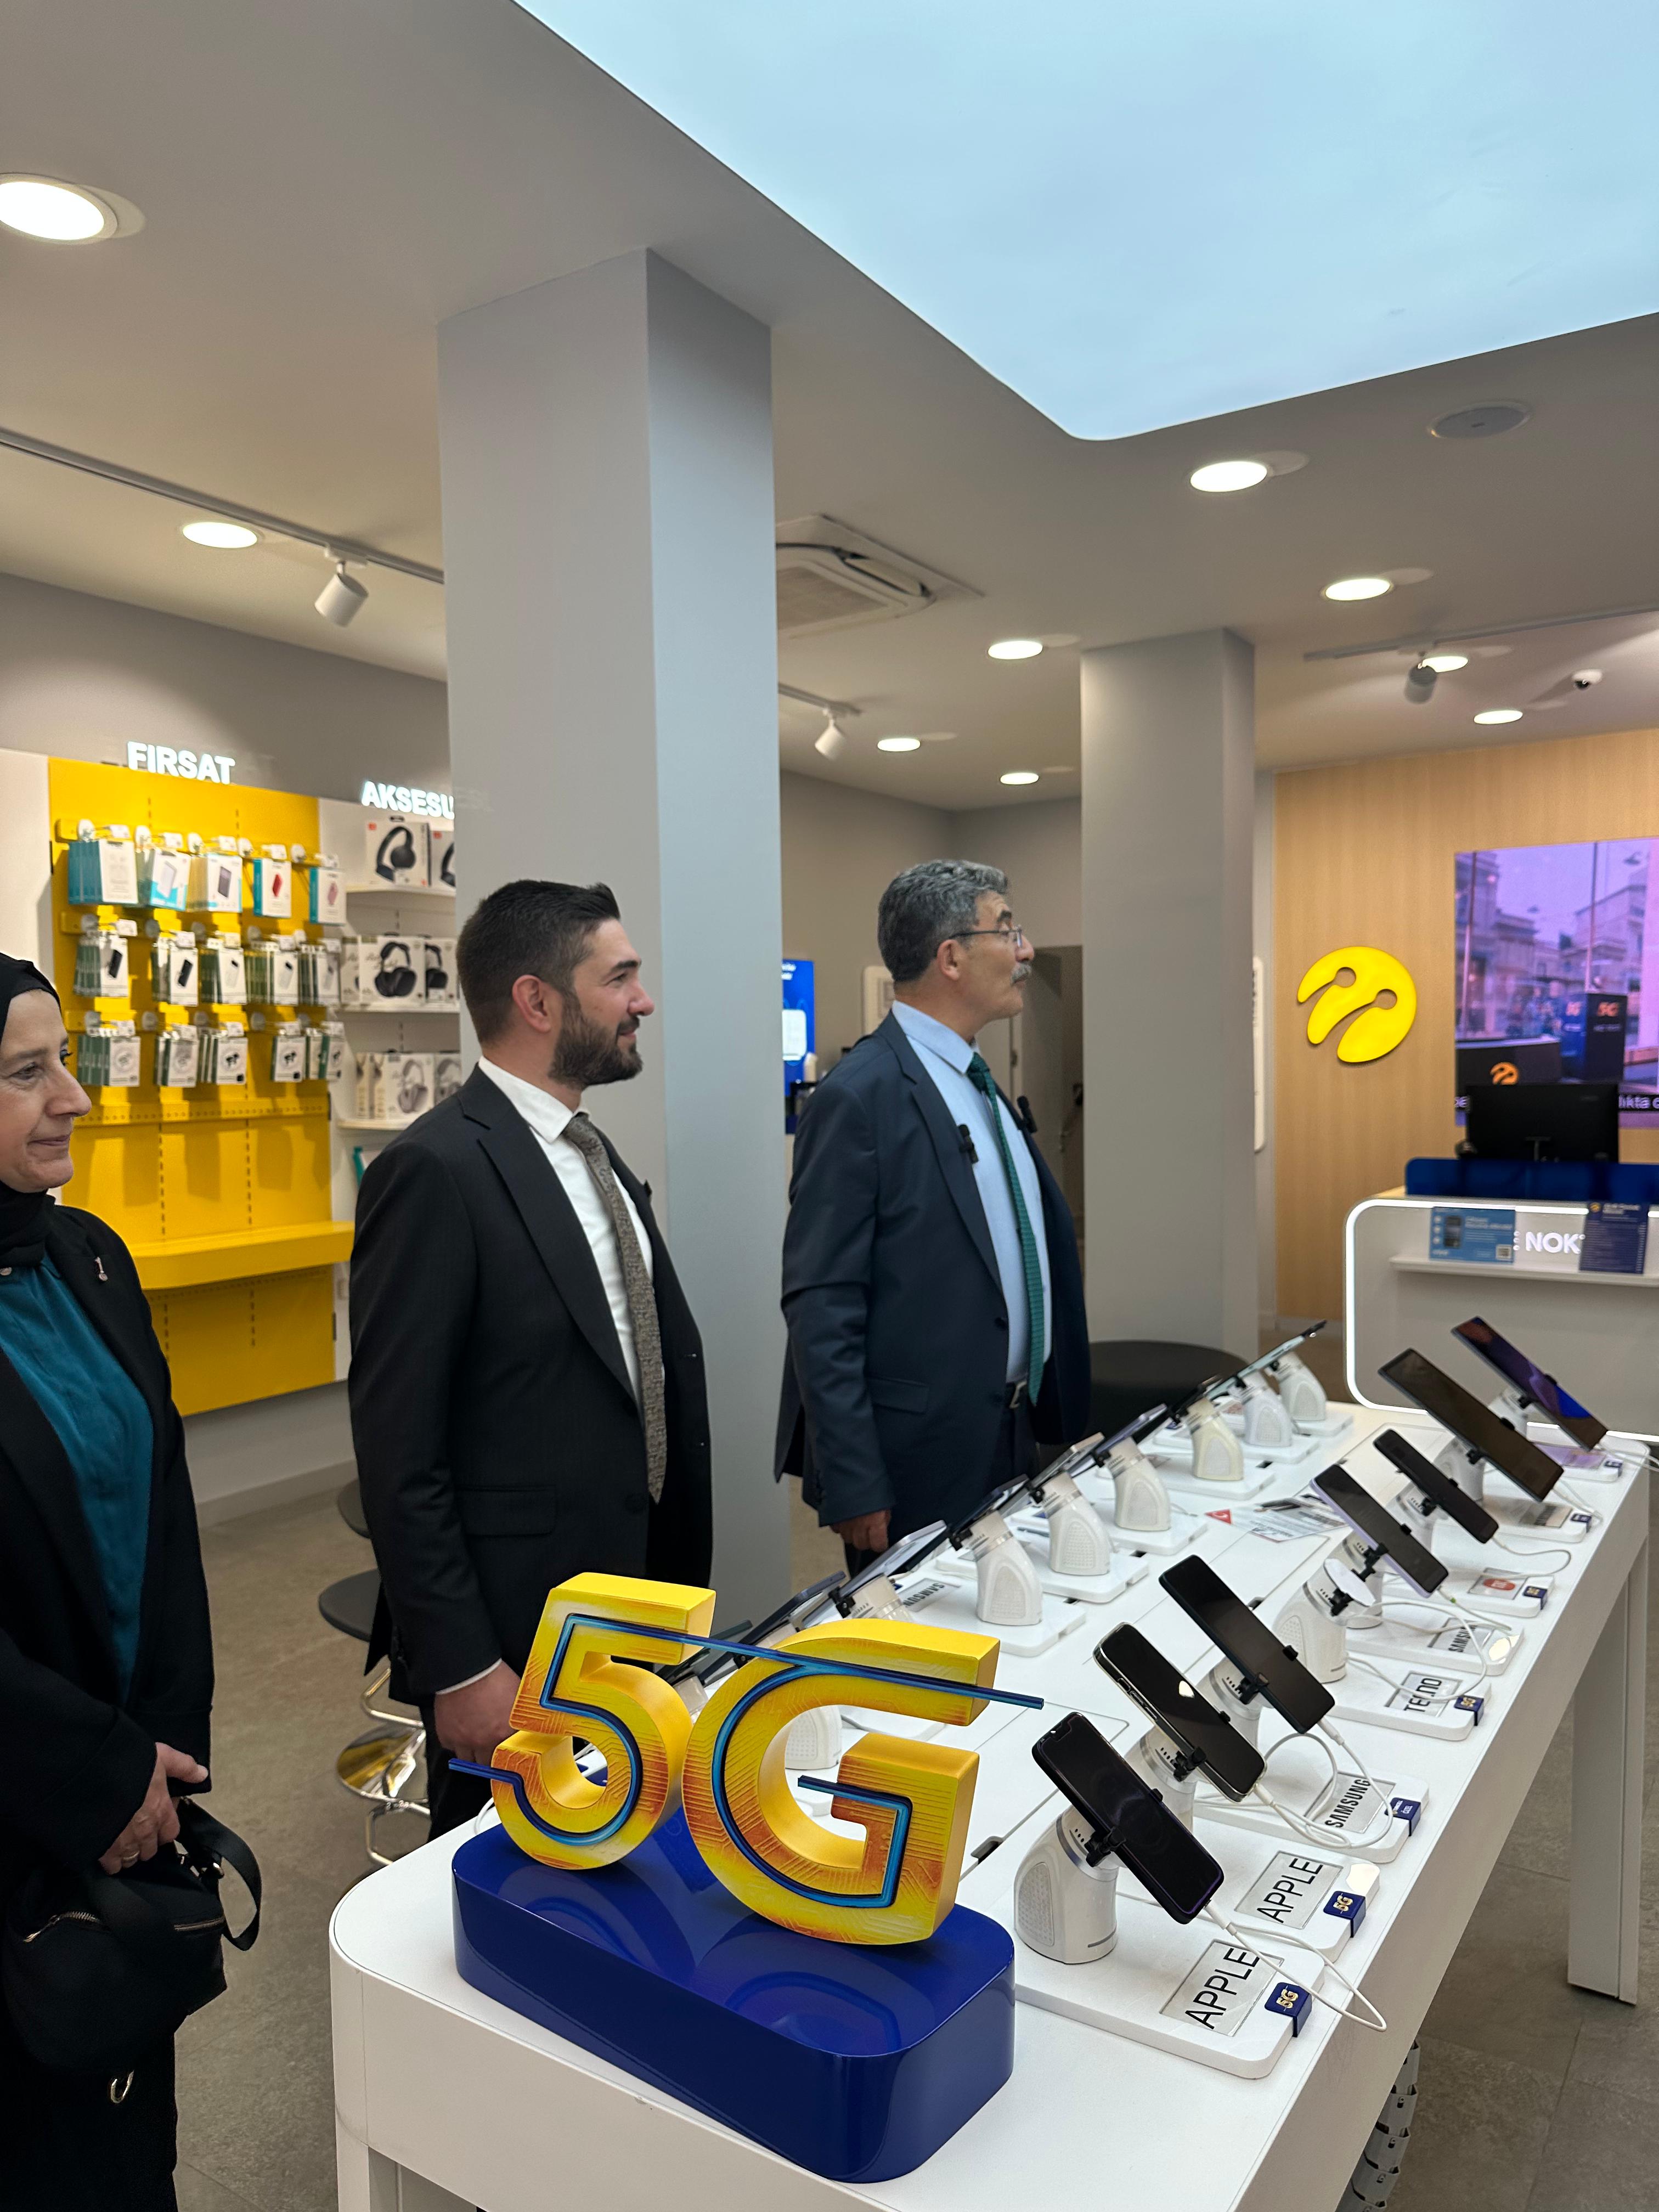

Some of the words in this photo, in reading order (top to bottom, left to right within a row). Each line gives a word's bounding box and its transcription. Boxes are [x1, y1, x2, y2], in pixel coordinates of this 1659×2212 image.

[127, 741, 235, 785] FIRSAT
[1525, 1231, 1585, 1255] NOK
[903, 1582, 945, 1607] SAMSUN
[1448, 1624, 1478, 1652] SAMSU
[491, 1571, 1001, 1945] 5G
[1324, 1779, 1372, 1828] SAMSUNG
[1256, 1858, 1324, 1923] APPLE
[1333, 1894, 1353, 1913] 5G
[1185, 1948, 1260, 2030] APPLE
[1276, 1987, 1299, 2010] 5G
